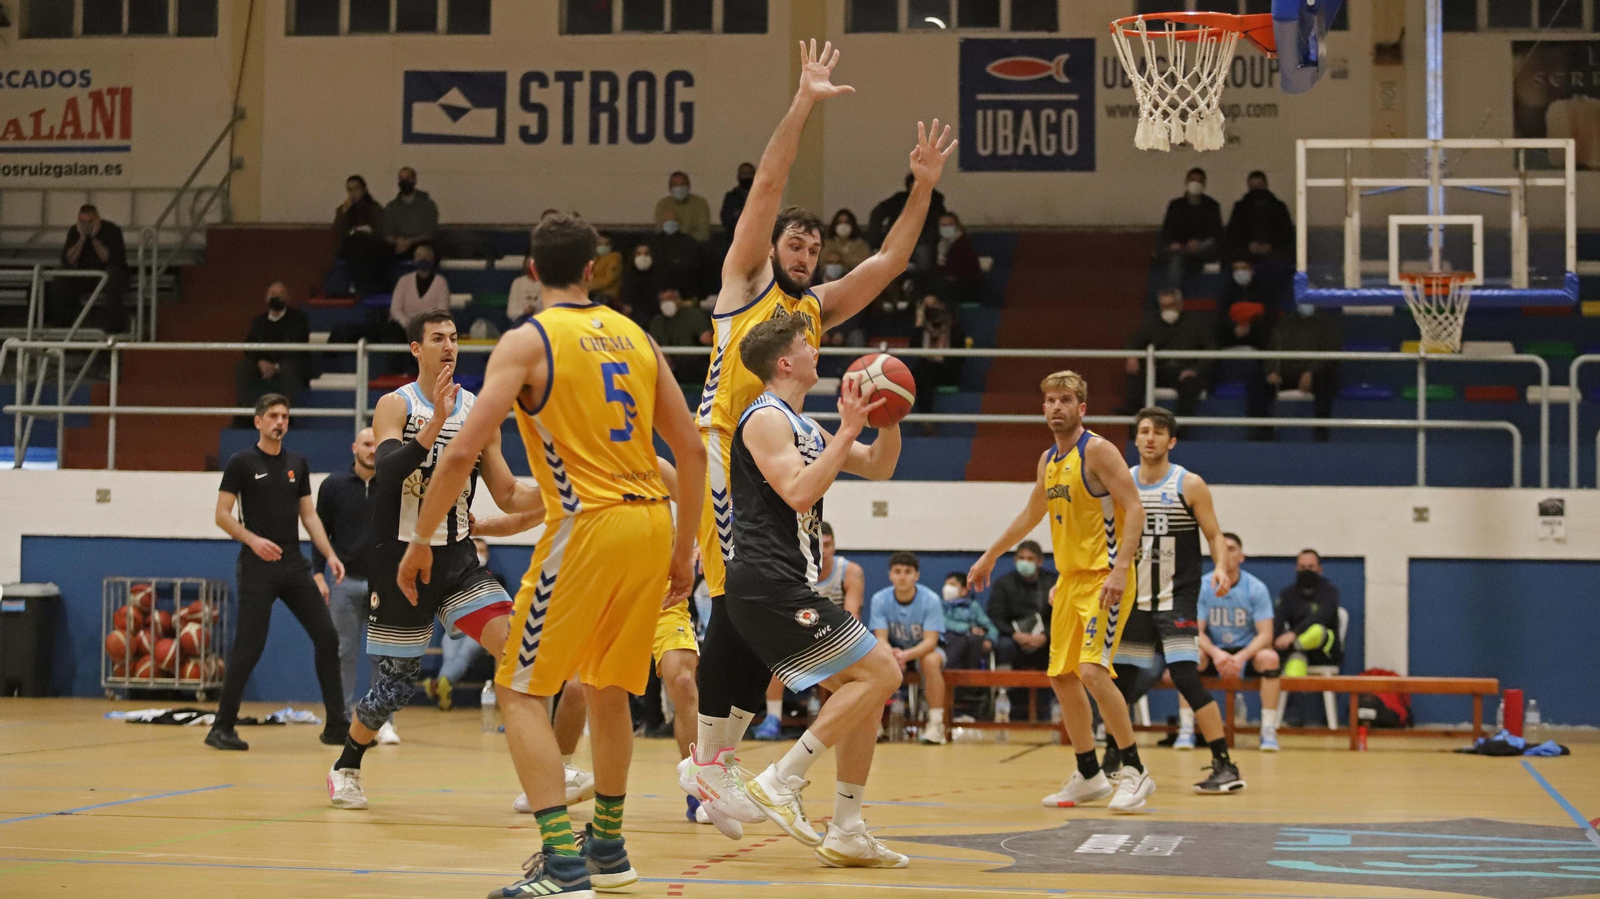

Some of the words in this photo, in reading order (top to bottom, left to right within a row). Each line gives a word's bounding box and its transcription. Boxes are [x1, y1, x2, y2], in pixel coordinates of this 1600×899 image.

[0, 70, 92, 89] CADOS
[518, 70, 695, 145] STROG
[976, 108, 1079, 156] UBAGO
[0, 162, 123, 178] osruizgalan.es
[580, 336, 635, 352] CHEMA
[600, 362, 638, 443] 5
[1085, 616, 1098, 638] 4
[1209, 606, 1248, 628] ULB
